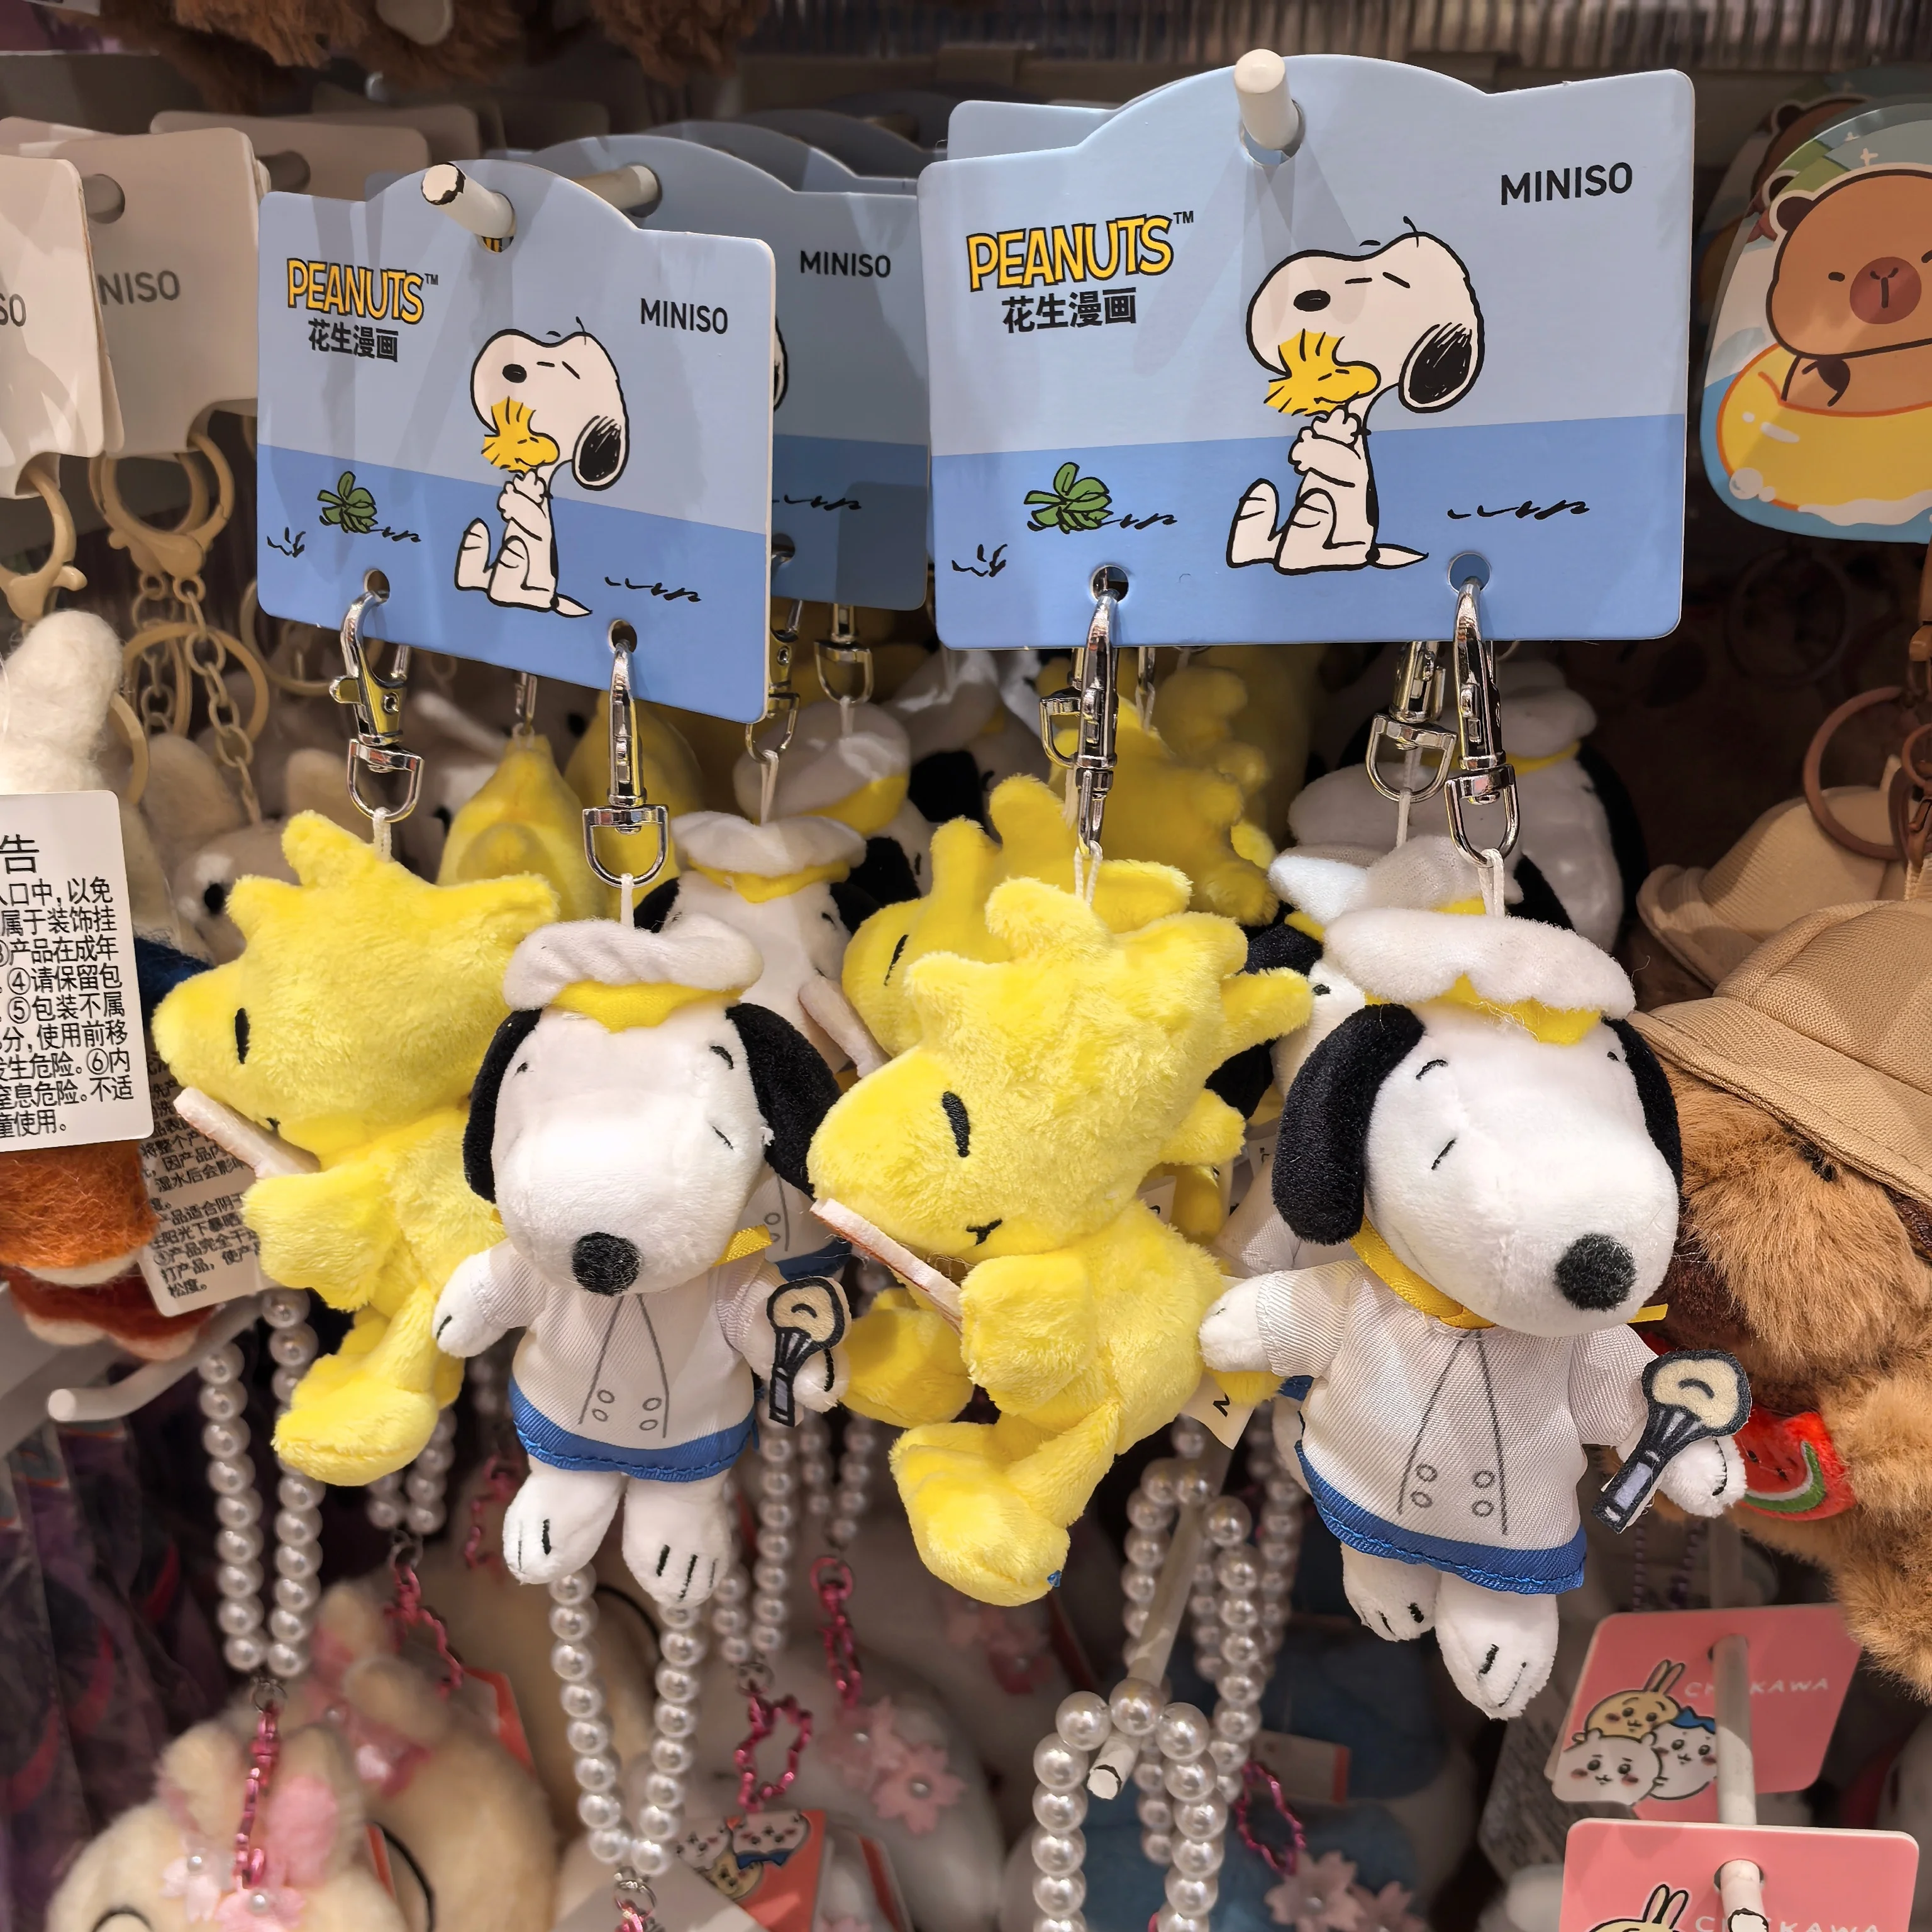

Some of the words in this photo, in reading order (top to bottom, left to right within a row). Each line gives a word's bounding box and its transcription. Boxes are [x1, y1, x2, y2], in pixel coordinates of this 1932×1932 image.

[1501, 162, 1633, 206] MINISO
[799, 250, 891, 279] MINISO
[640, 297, 729, 335] MINISO
[1001, 287, 1137, 333] 花生漫画
[308, 317, 399, 363] 花生漫画
[0, 1018, 128, 1053] 分，使用前移
